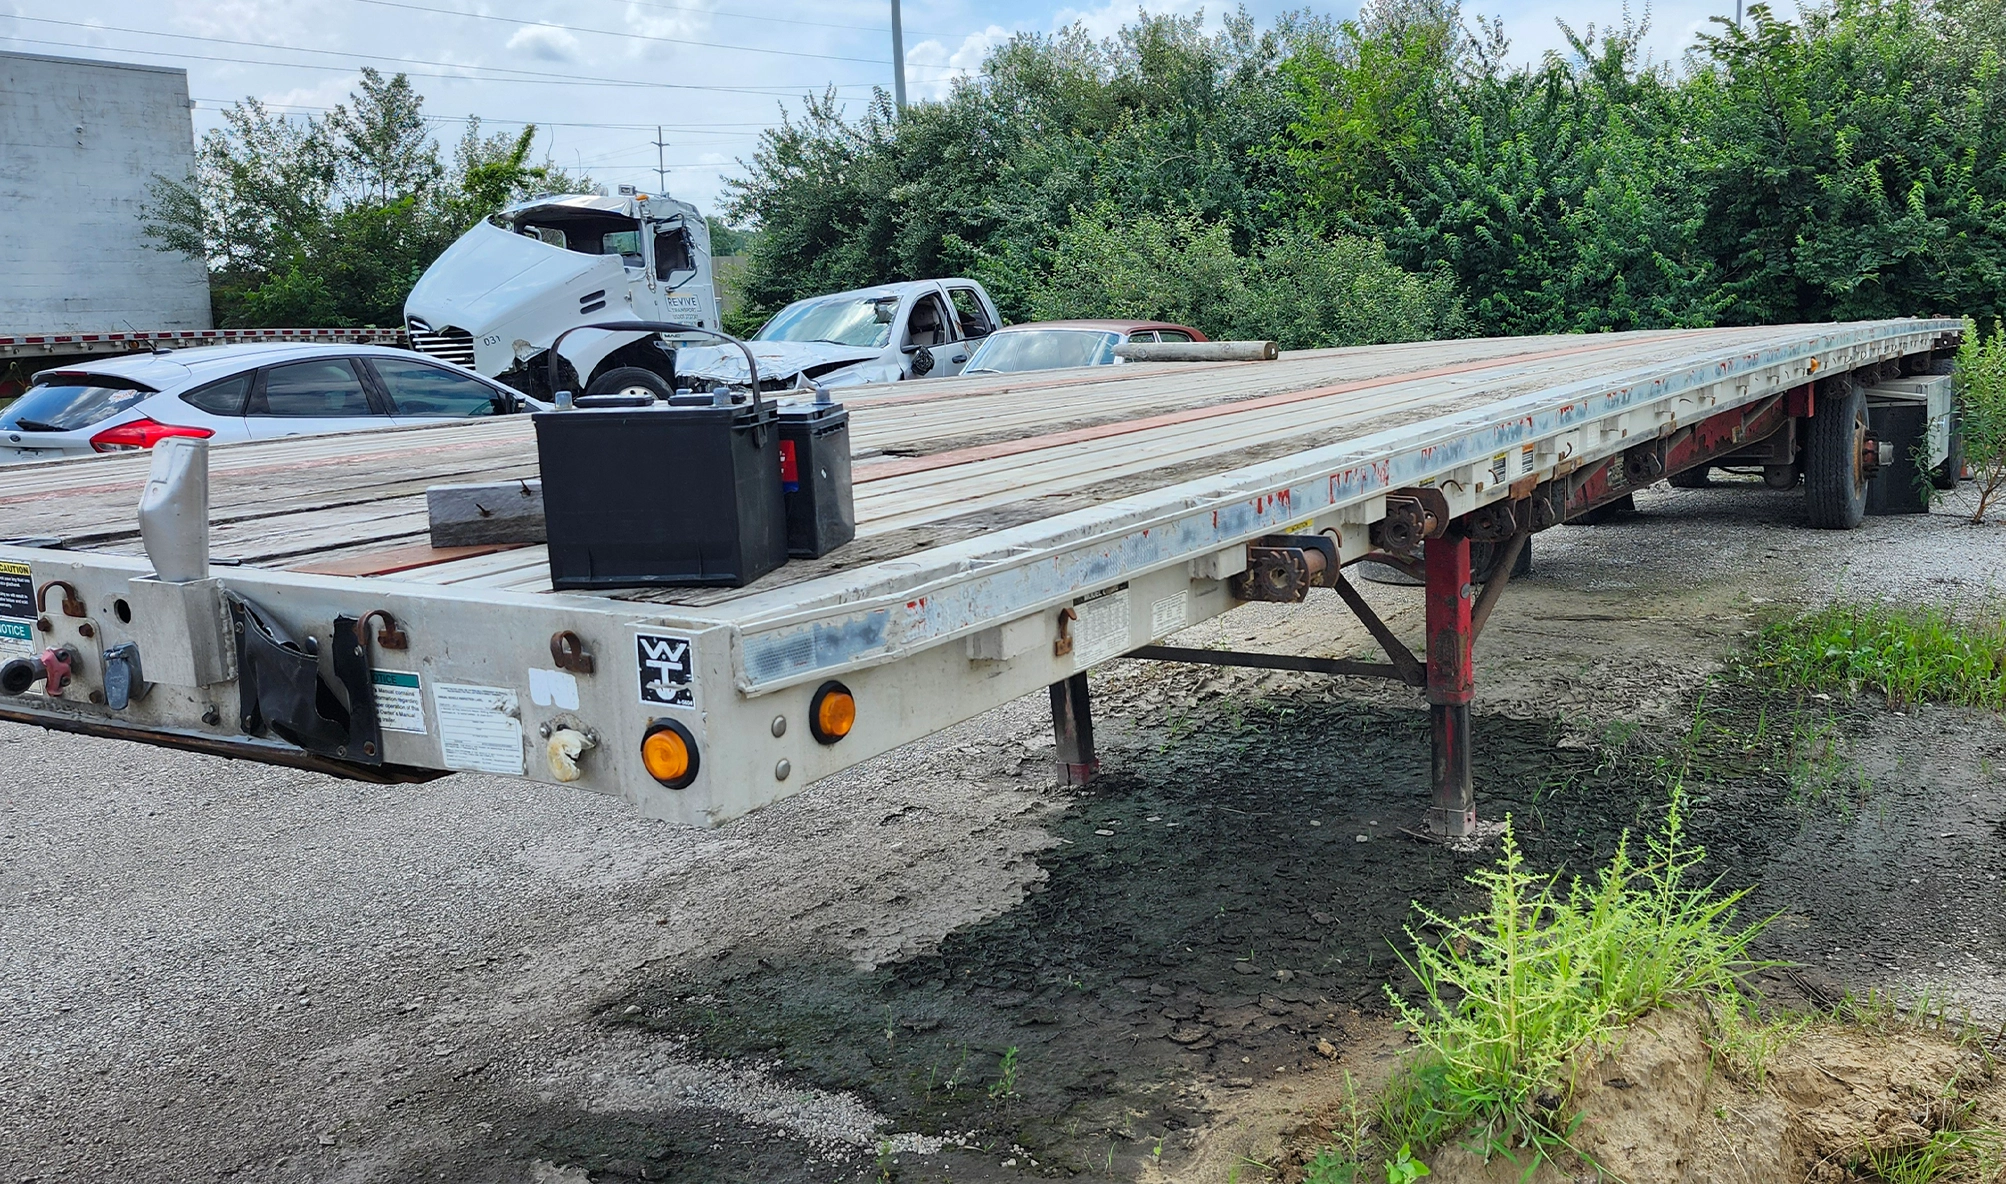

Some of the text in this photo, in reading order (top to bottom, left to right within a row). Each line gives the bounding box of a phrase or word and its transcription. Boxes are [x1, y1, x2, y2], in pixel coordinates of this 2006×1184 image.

[667, 297, 697, 306] REVIVE
[0, 563, 30, 575] CAUTION
[0, 624, 26, 637] OTICE
[372, 673, 397, 685] OTICE
